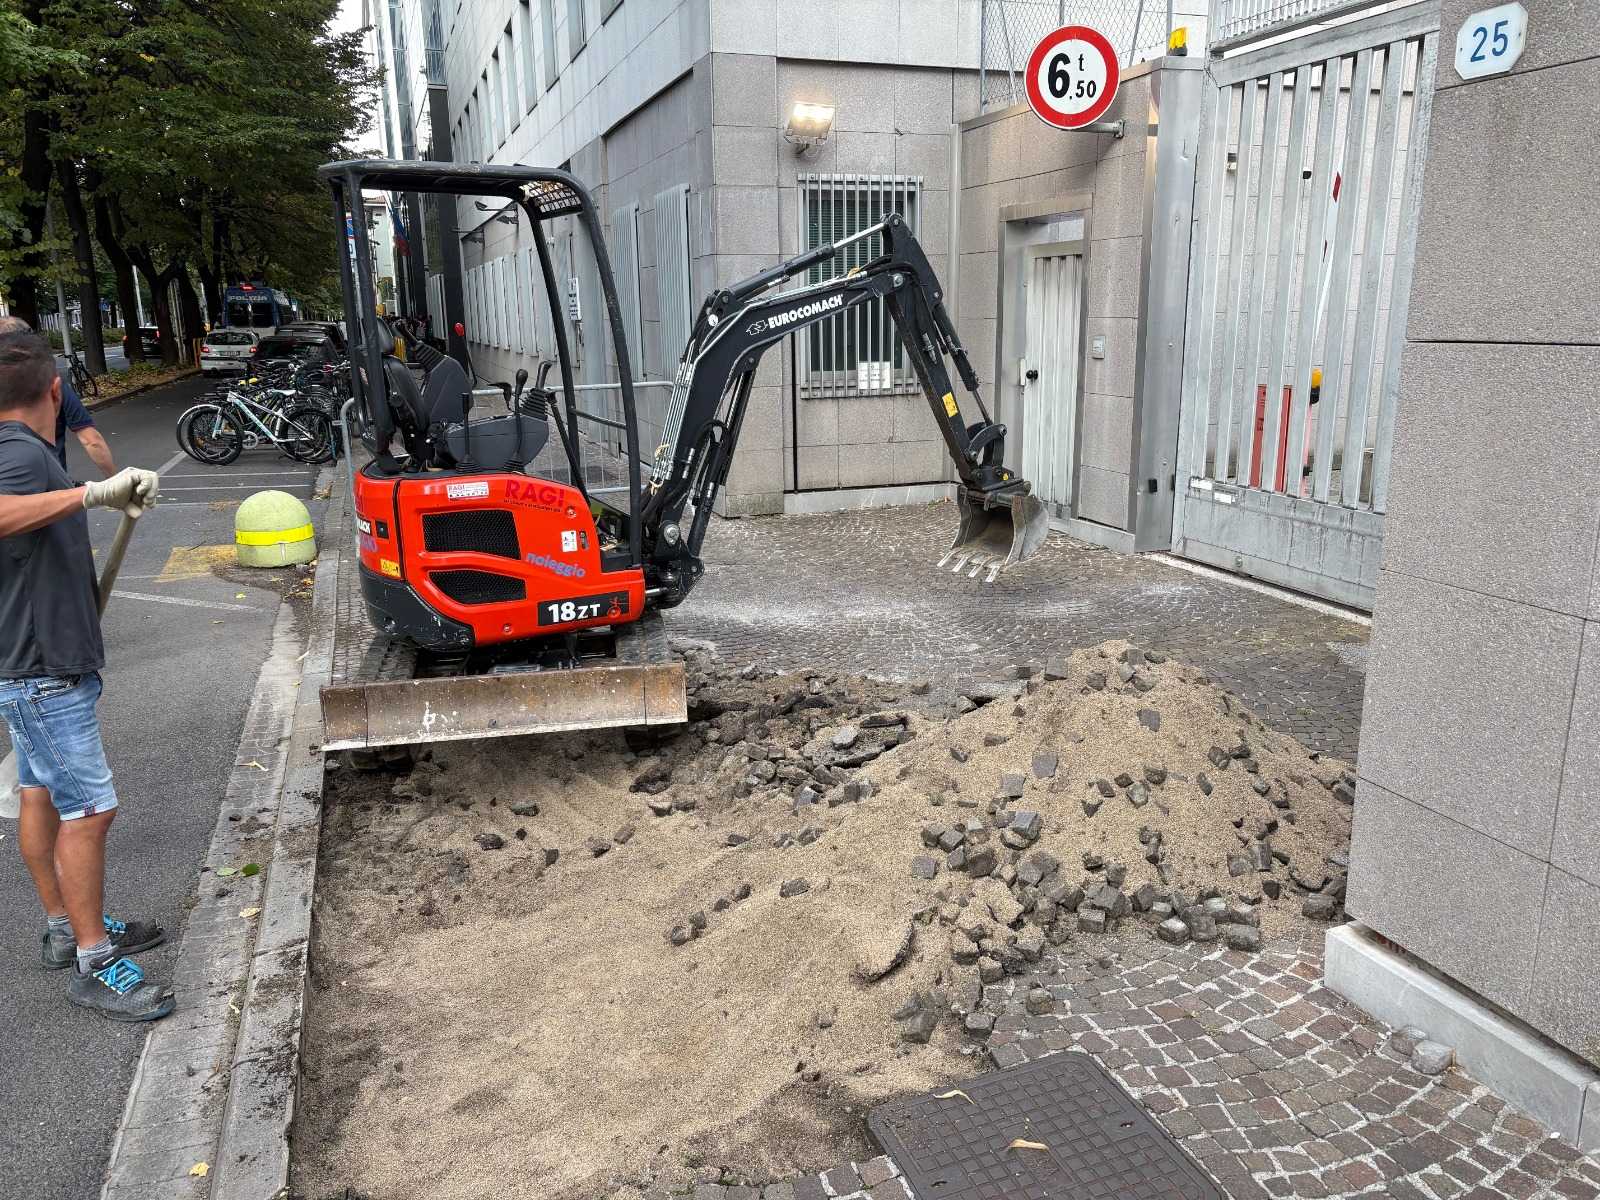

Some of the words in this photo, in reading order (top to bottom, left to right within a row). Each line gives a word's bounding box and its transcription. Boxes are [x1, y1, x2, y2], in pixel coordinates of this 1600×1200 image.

[1470, 20, 1508, 62] 25
[1078, 53, 1084, 71] t
[767, 295, 842, 329] EUROCOMACH
[527, 553, 586, 578] noleggio
